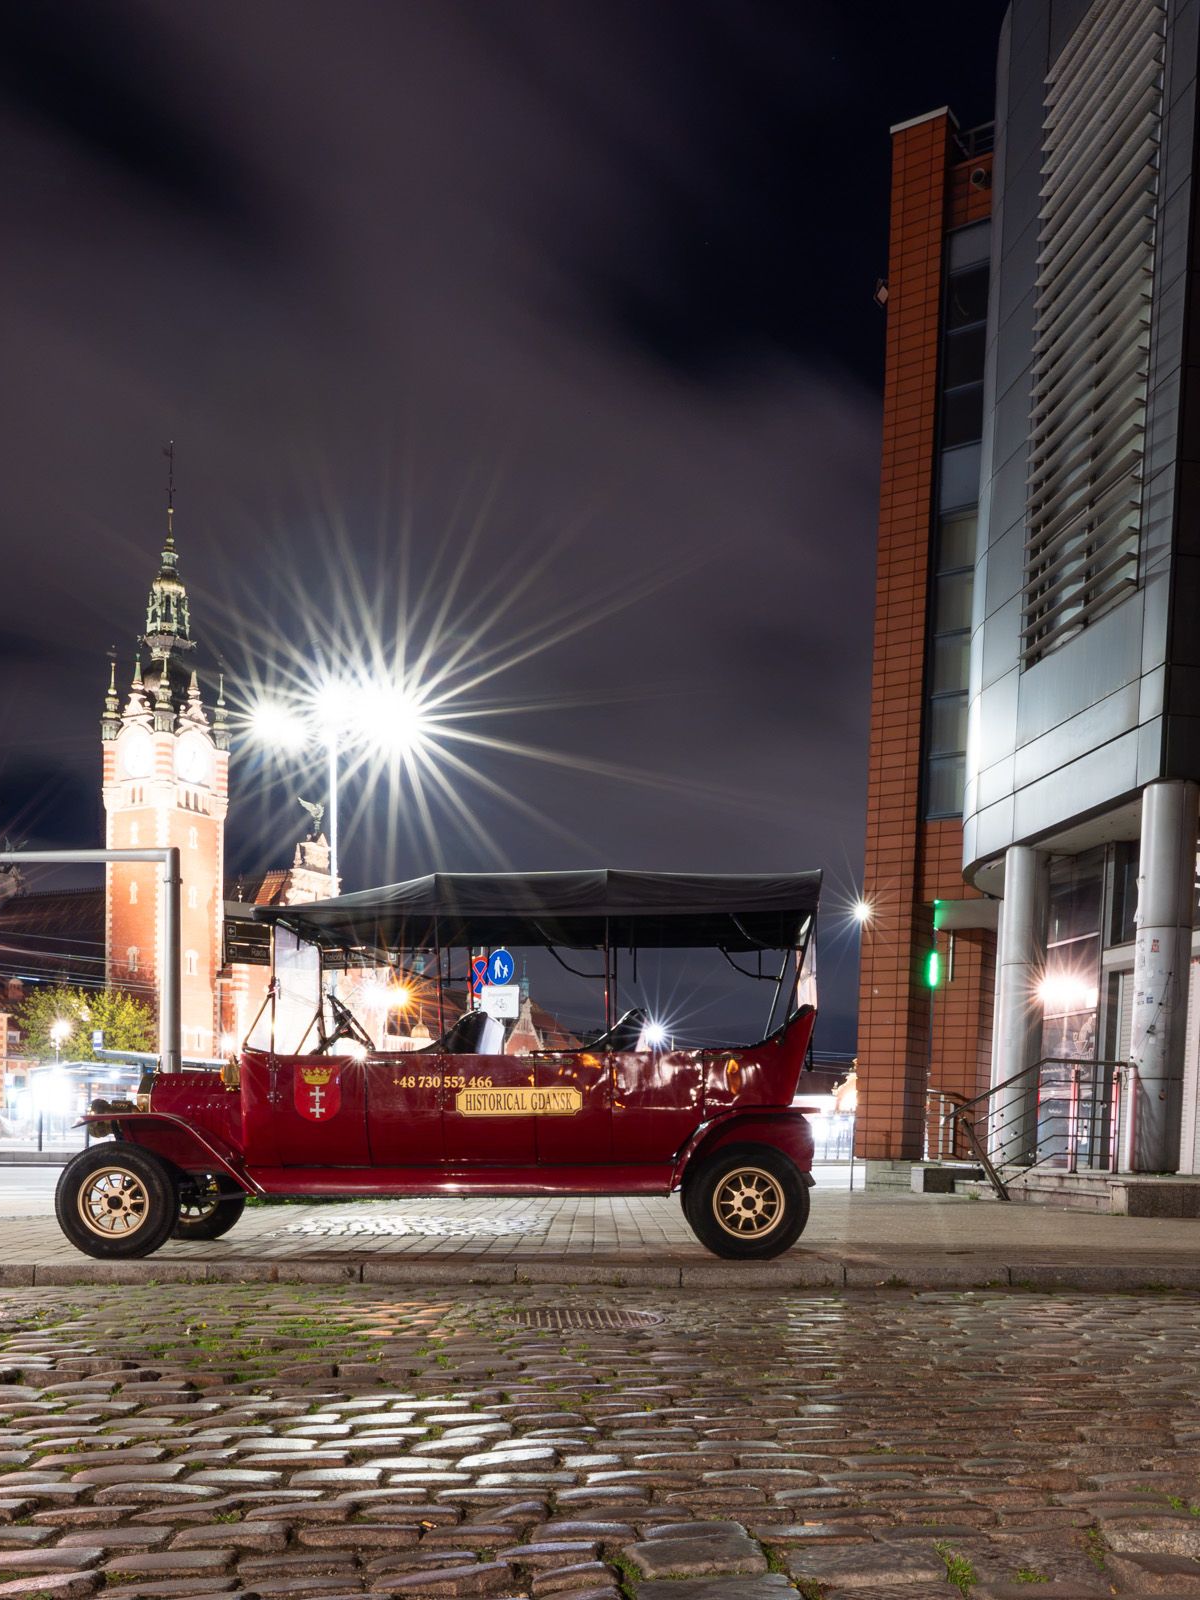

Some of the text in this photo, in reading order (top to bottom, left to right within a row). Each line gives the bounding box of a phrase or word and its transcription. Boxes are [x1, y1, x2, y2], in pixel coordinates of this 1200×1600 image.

[393, 1075, 493, 1088] +48 730 552 466
[465, 1092, 573, 1111] HISTORICAL GDANSK
